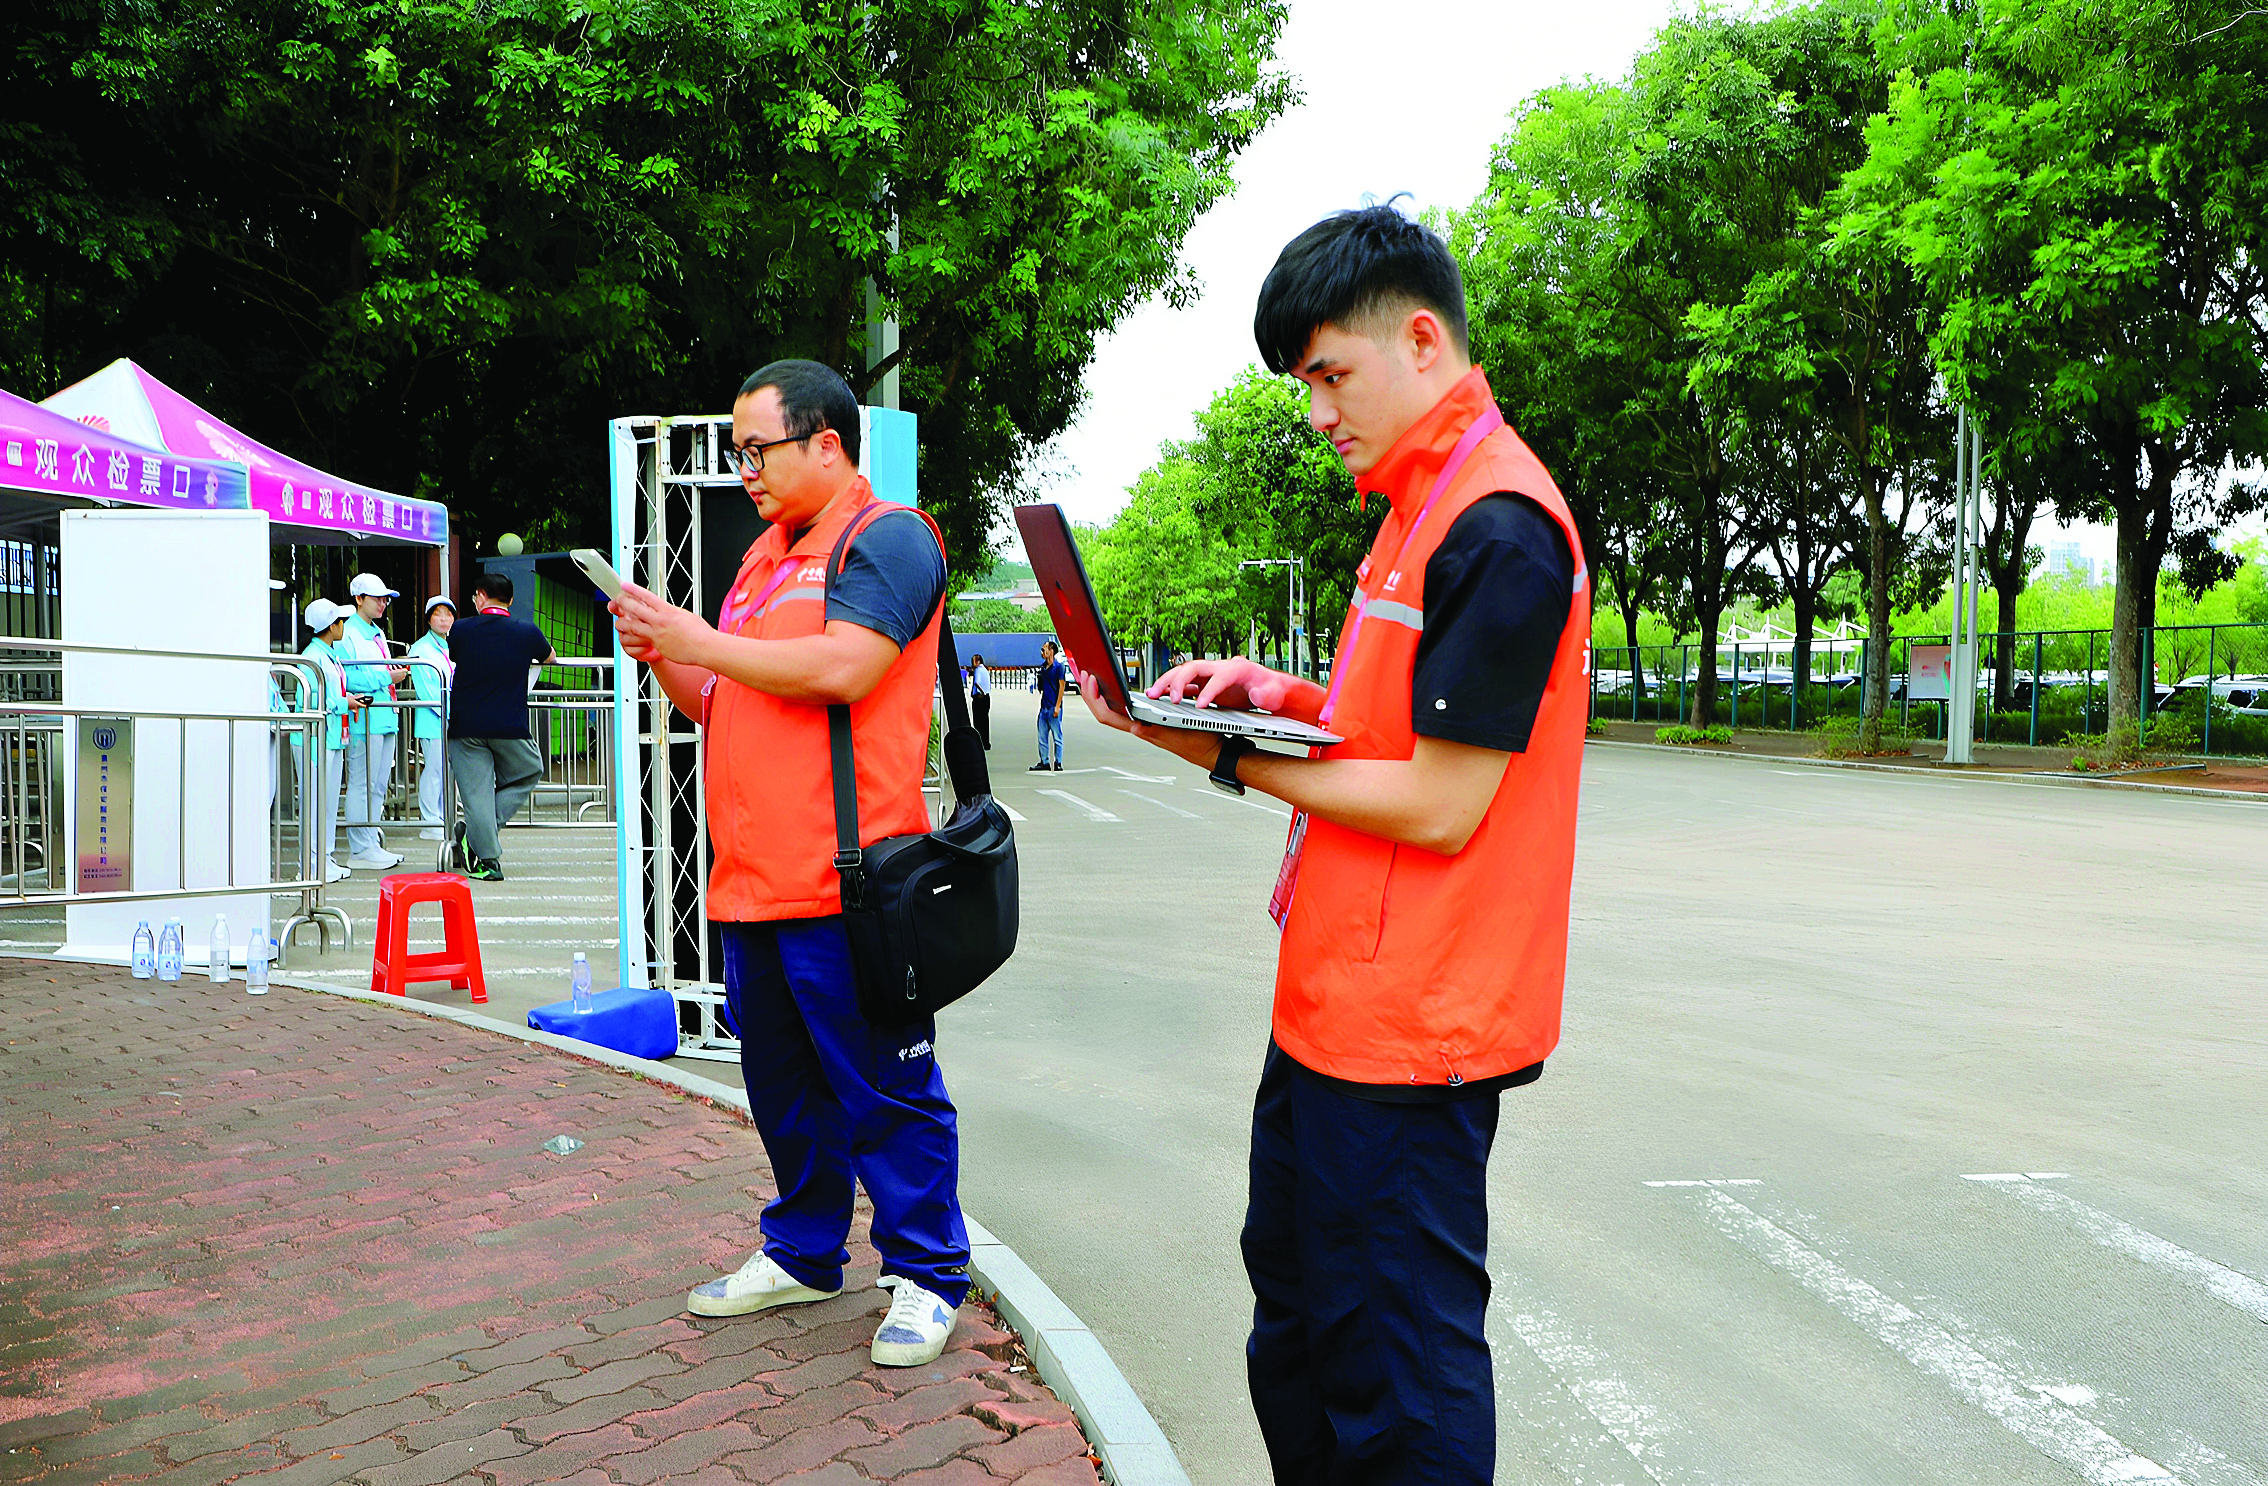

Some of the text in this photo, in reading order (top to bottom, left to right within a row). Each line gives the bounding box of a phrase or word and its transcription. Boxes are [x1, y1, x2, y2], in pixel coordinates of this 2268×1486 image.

[35, 438, 191, 499] 观众检票口
[318, 487, 413, 531] 观众检票口
